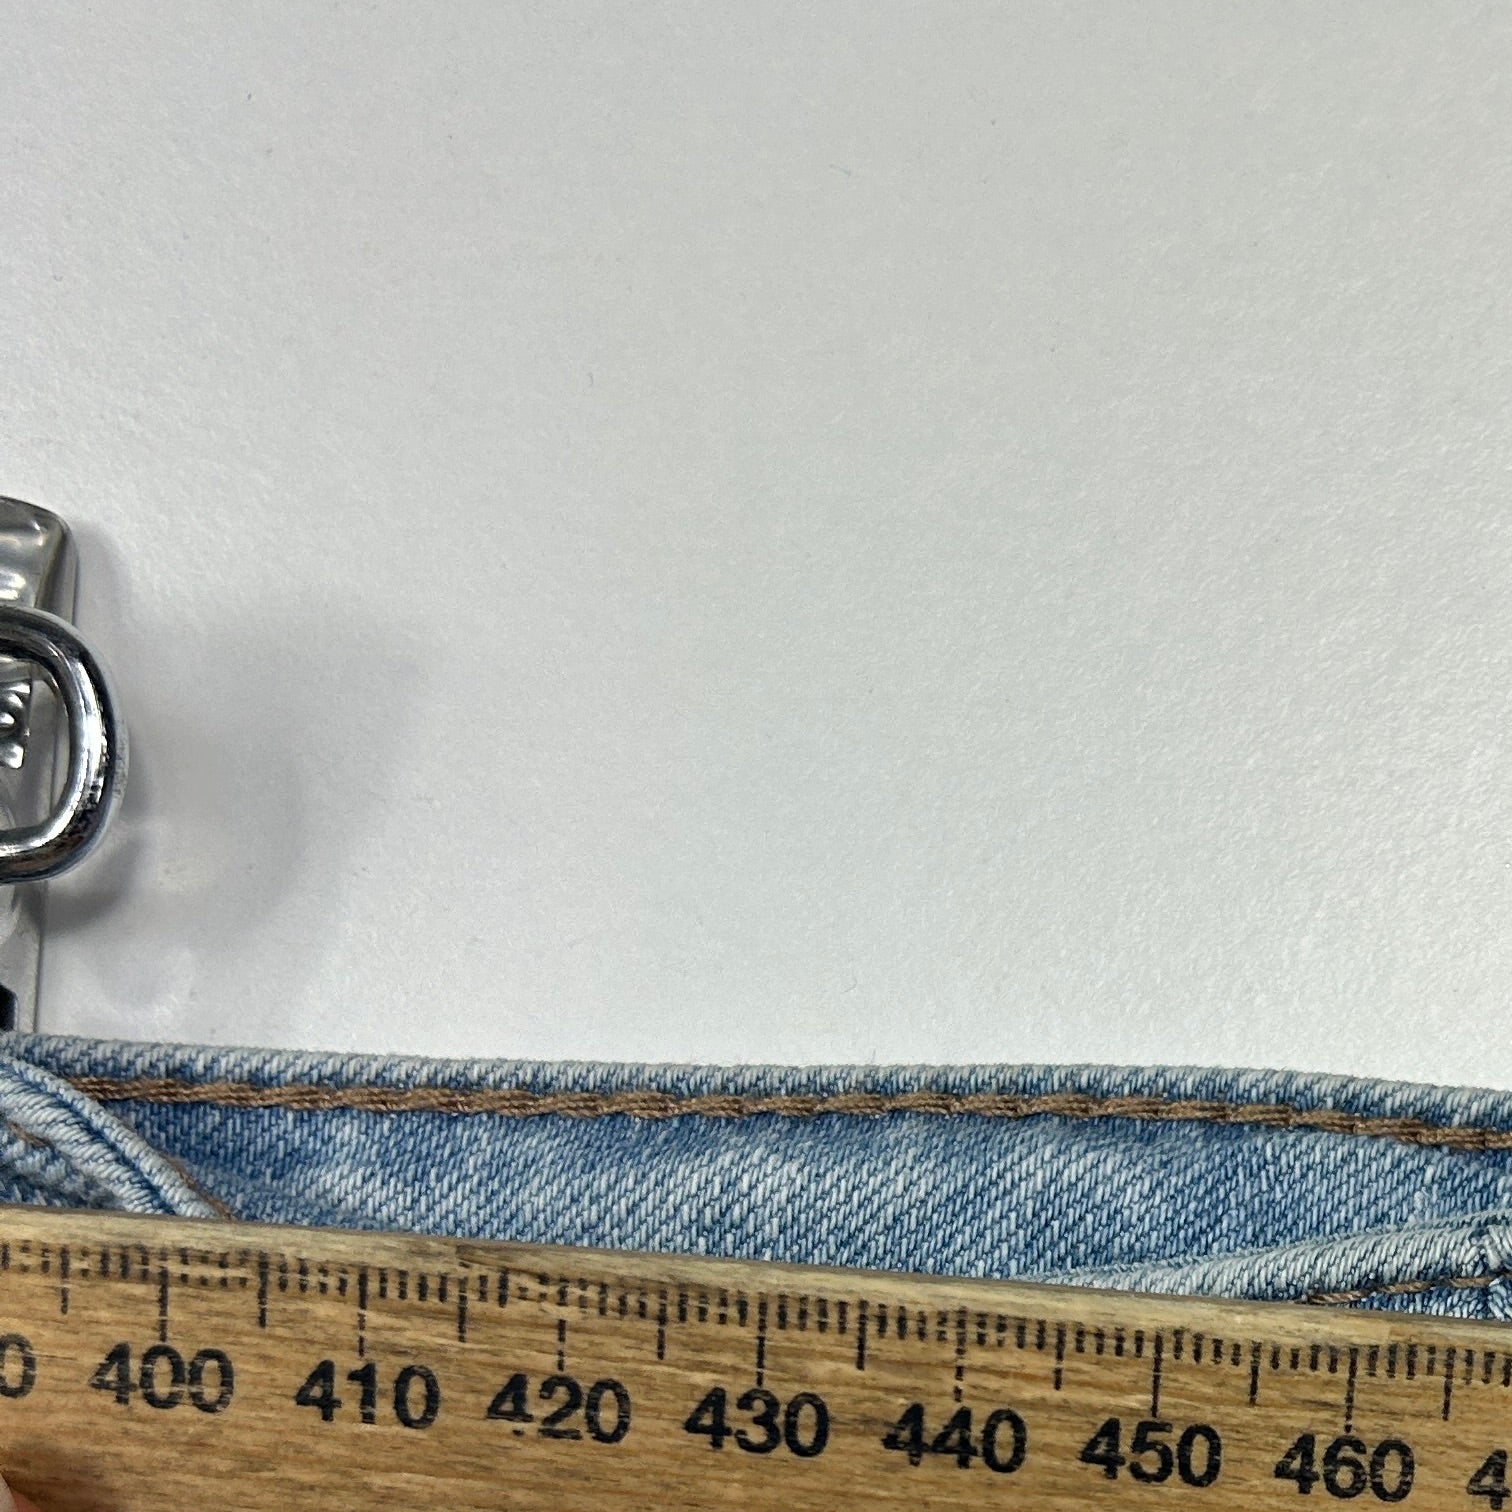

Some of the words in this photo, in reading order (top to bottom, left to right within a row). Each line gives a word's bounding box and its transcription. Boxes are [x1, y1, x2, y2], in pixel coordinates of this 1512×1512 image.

[90, 1342, 235, 1414] 400
[293, 1358, 442, 1430] 410
[487, 1374, 632, 1444] 420
[683, 1386, 831, 1458] 430
[879, 1403, 1028, 1474] 440
[1078, 1416, 1222, 1488] 450
[1273, 1432, 1416, 1503] 460
